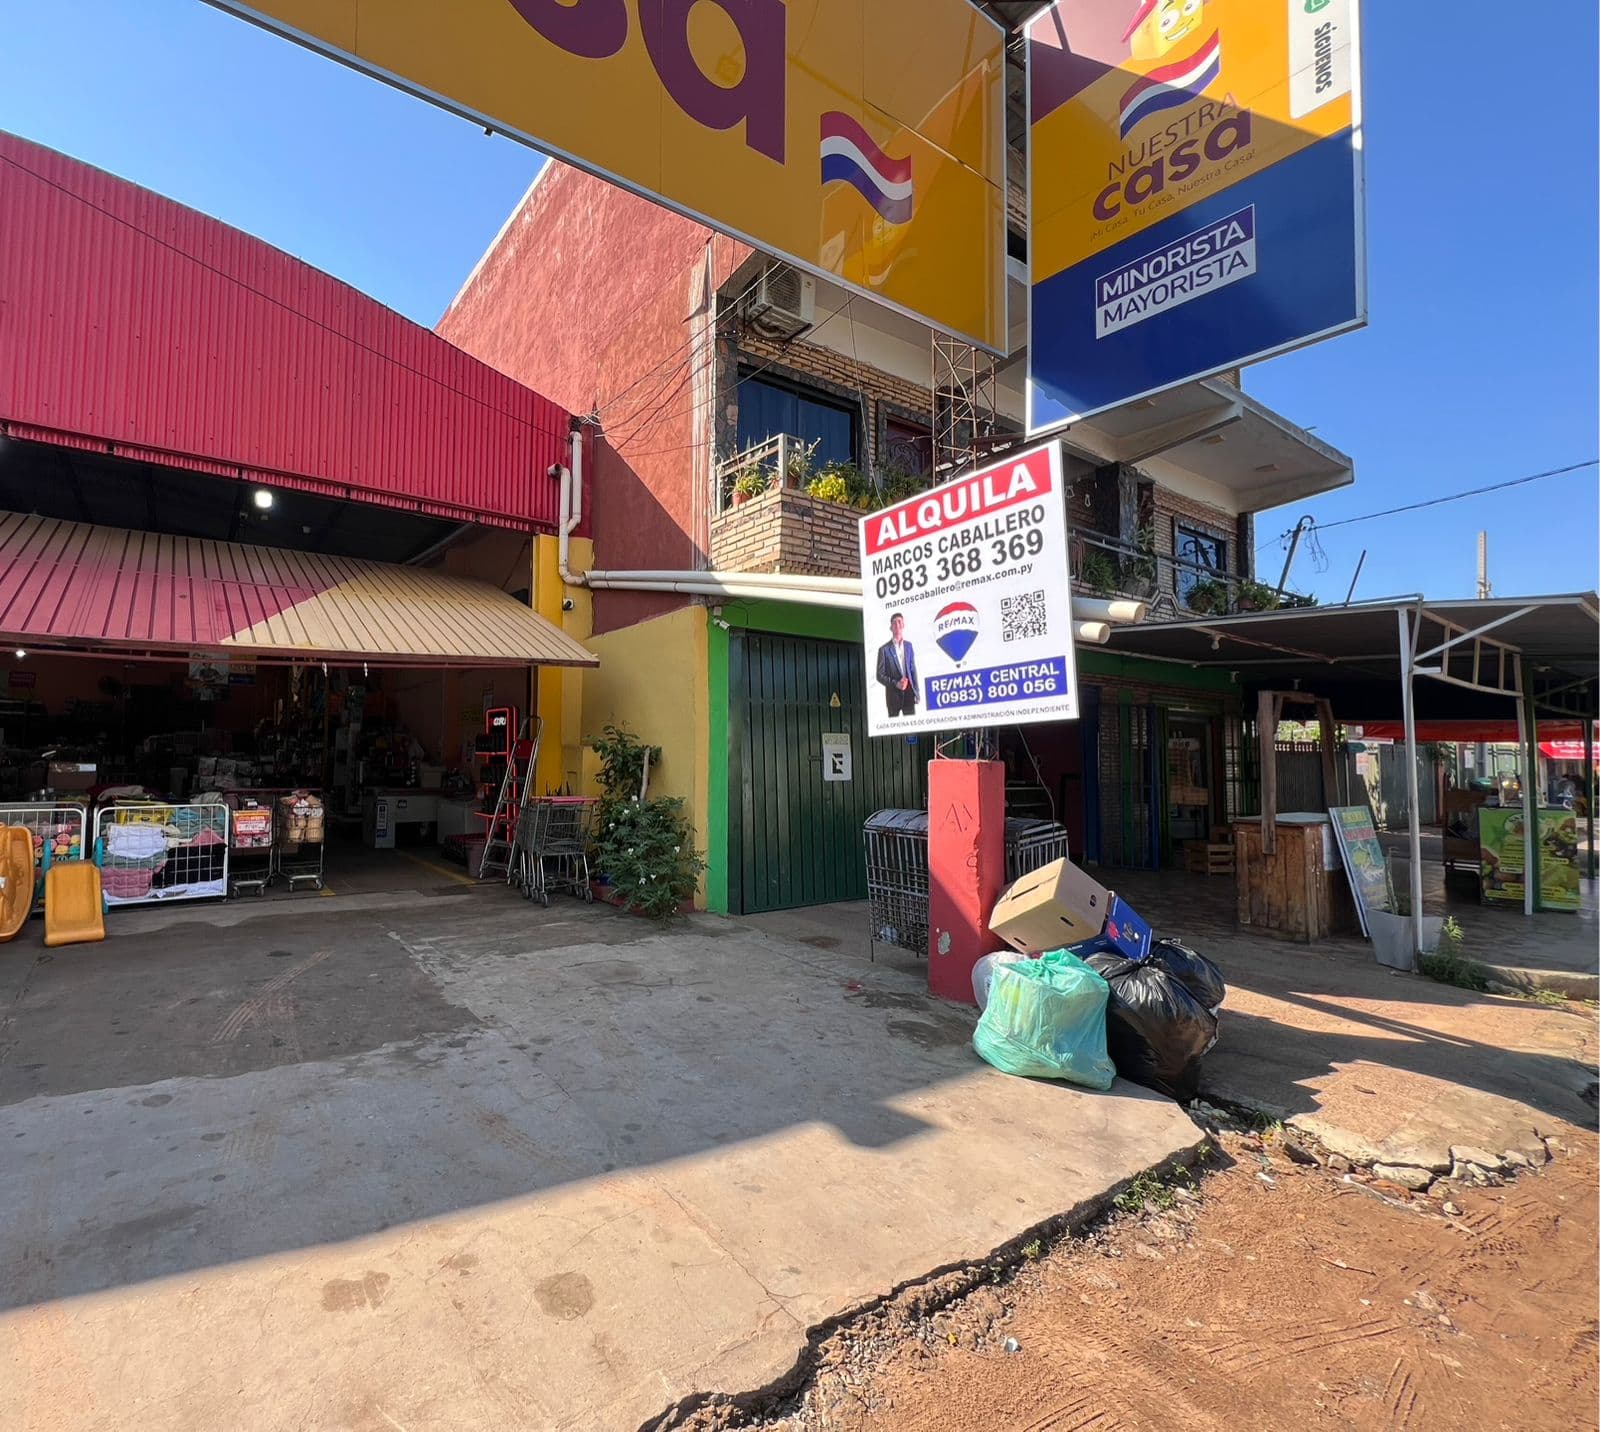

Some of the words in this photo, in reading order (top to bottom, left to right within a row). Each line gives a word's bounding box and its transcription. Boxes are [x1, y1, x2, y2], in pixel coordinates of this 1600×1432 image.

[1093, 110, 1251, 221] casa
[1108, 92, 1237, 180] NUESTRA
[1103, 220, 1246, 302] MINORISTA
[1104, 250, 1249, 328] MAYORISTA
[872, 541, 933, 576] MARCOS
[938, 504, 1046, 554] CABALLERO
[876, 463, 1038, 546] ALQUILA
[876, 564, 928, 599] 0983
[936, 548, 982, 582] 368
[991, 528, 1044, 567] 369
[938, 616, 976, 633] RE/MAX
[931, 673, 983, 693] RE/MAX
[990, 662, 1060, 684] CENTRAL
[936, 687, 984, 707] (0983)
[987, 683, 1018, 699] 800
[1023, 677, 1057, 694] 056
[1015, 703, 1070, 716] INDEPENDIENTE
